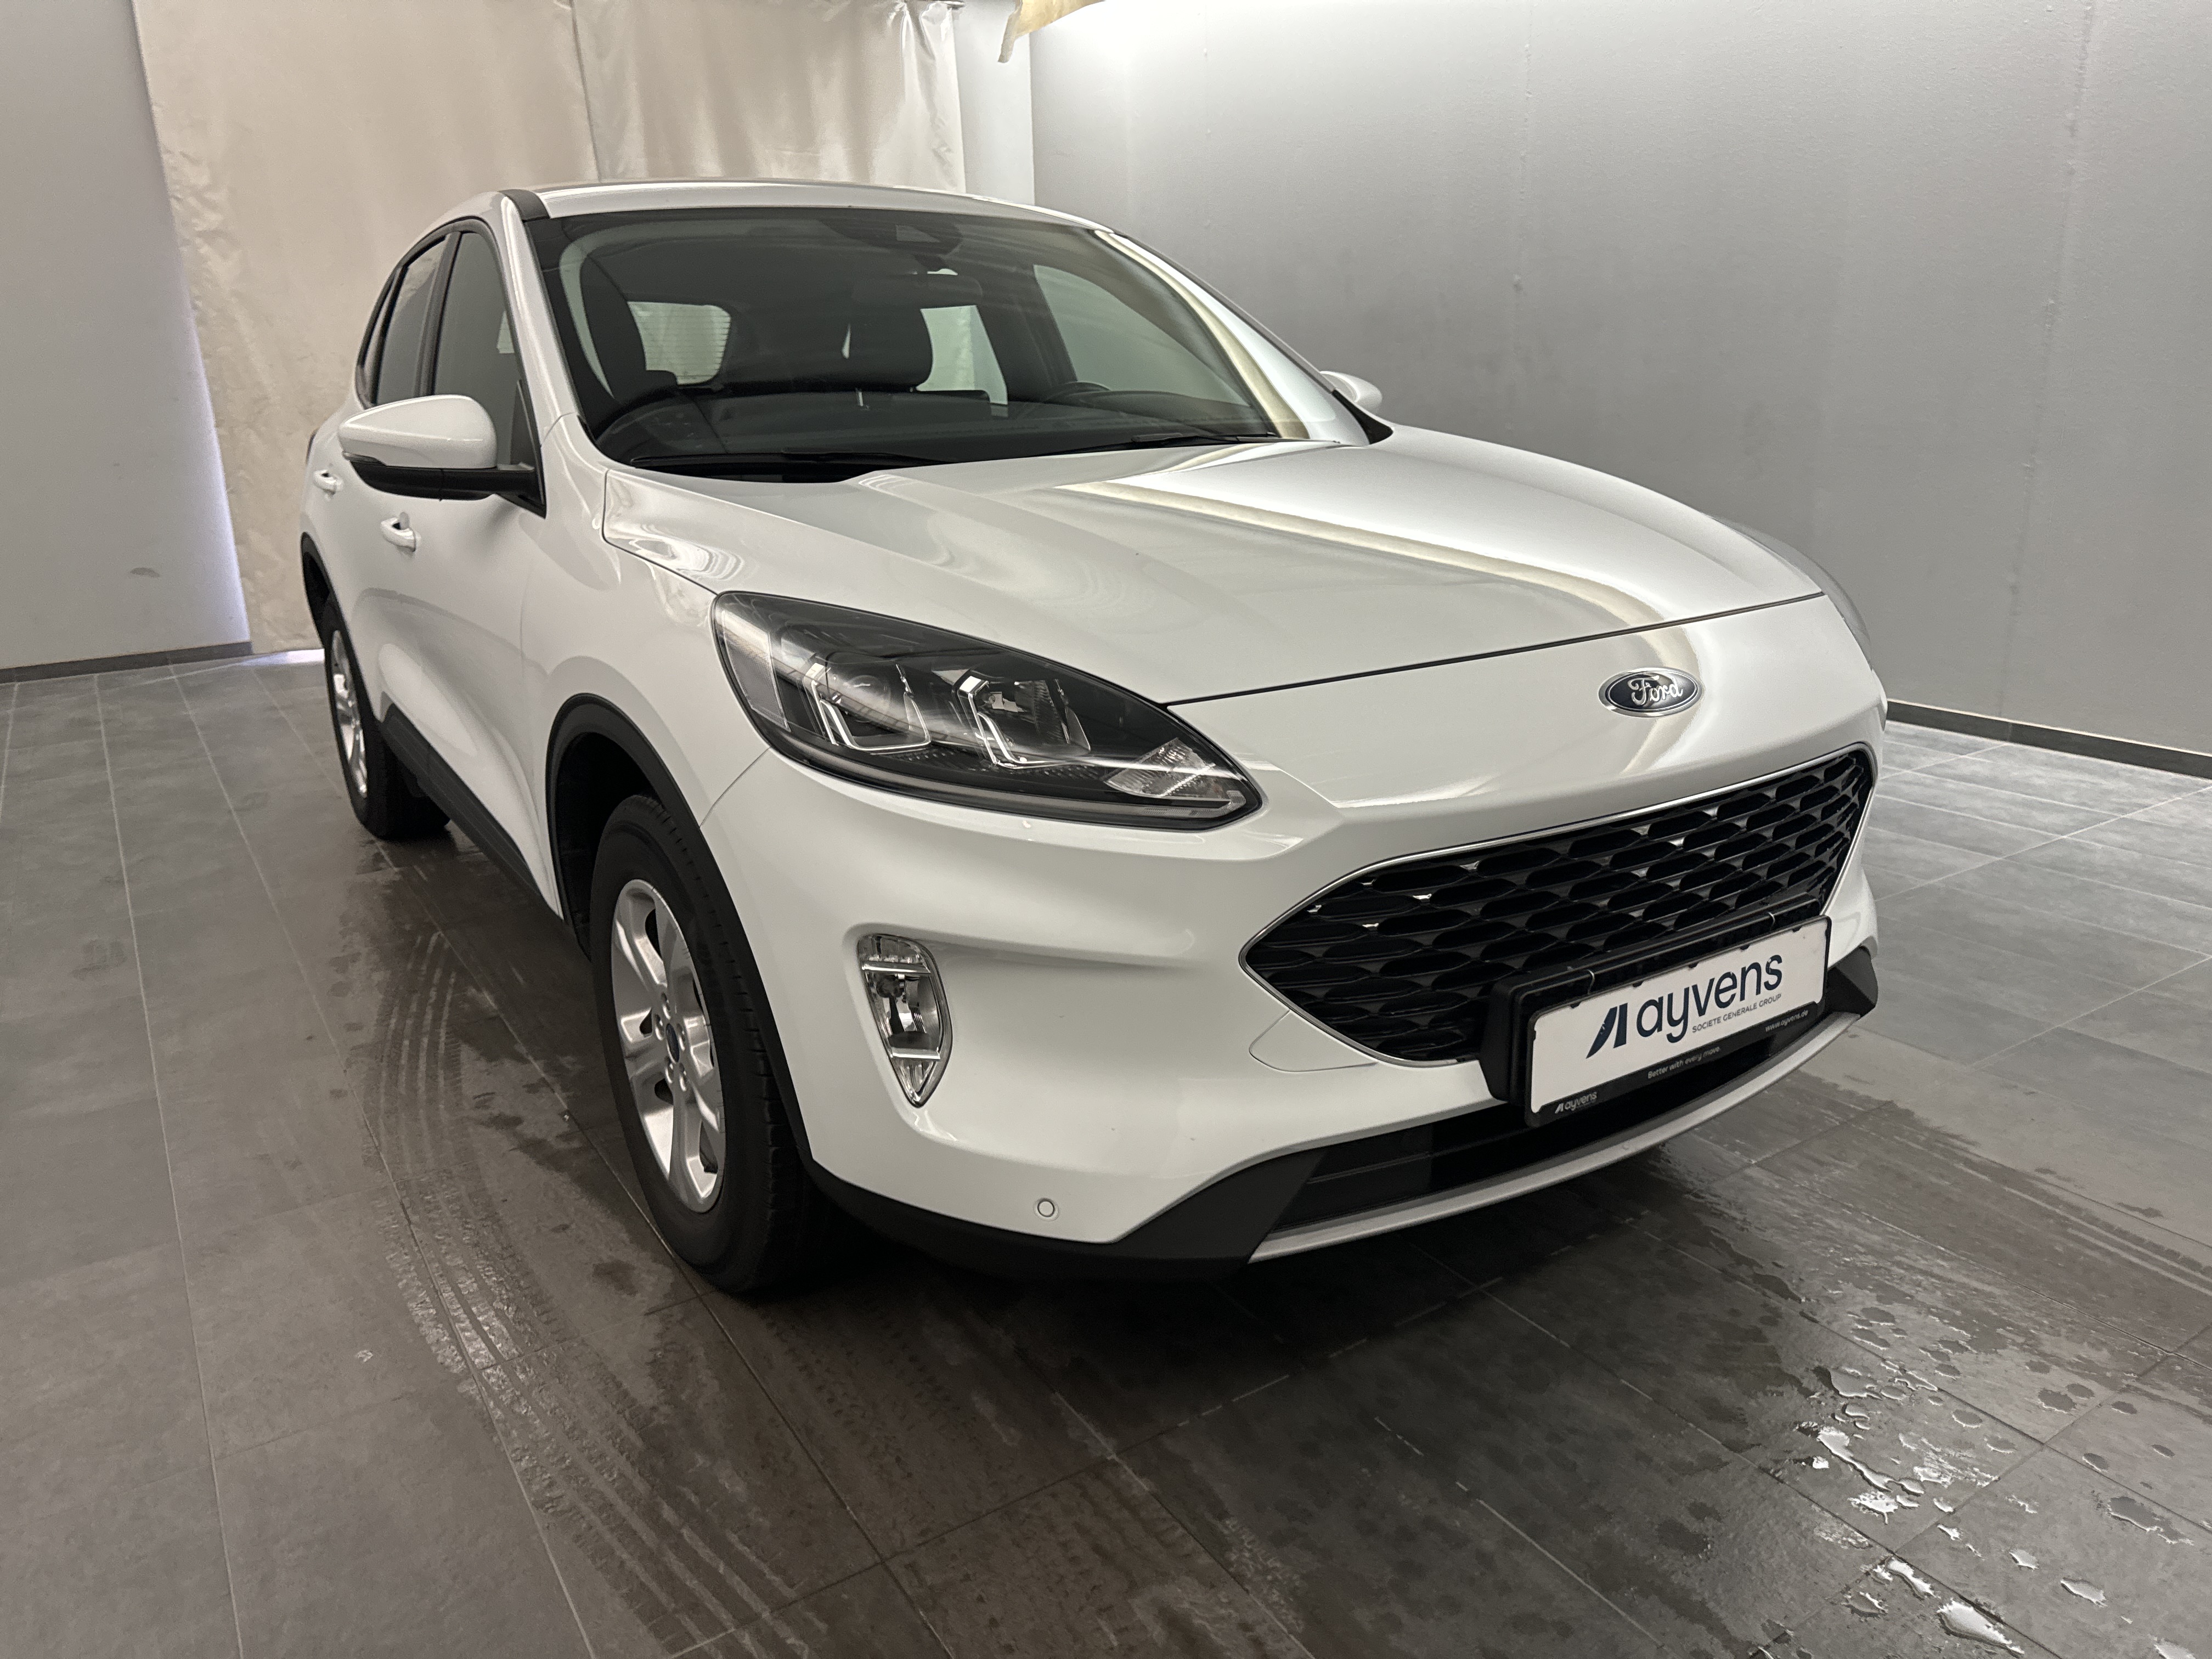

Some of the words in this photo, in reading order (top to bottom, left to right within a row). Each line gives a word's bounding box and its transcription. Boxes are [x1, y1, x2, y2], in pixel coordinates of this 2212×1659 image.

[1628, 675, 1683, 706] Ford
[1637, 955, 1783, 1043] ayvens
[1692, 1016, 1722, 1033] SOCIETE
[1723, 1002, 1758, 1022] GENERALE
[1759, 993, 1782, 1008] GROUP
[1647, 1066, 1668, 1079] Better
[1669, 1059, 1684, 1070] with
[1684, 1053, 1702, 1065] every
[1564, 1091, 1598, 1111] ayvens
